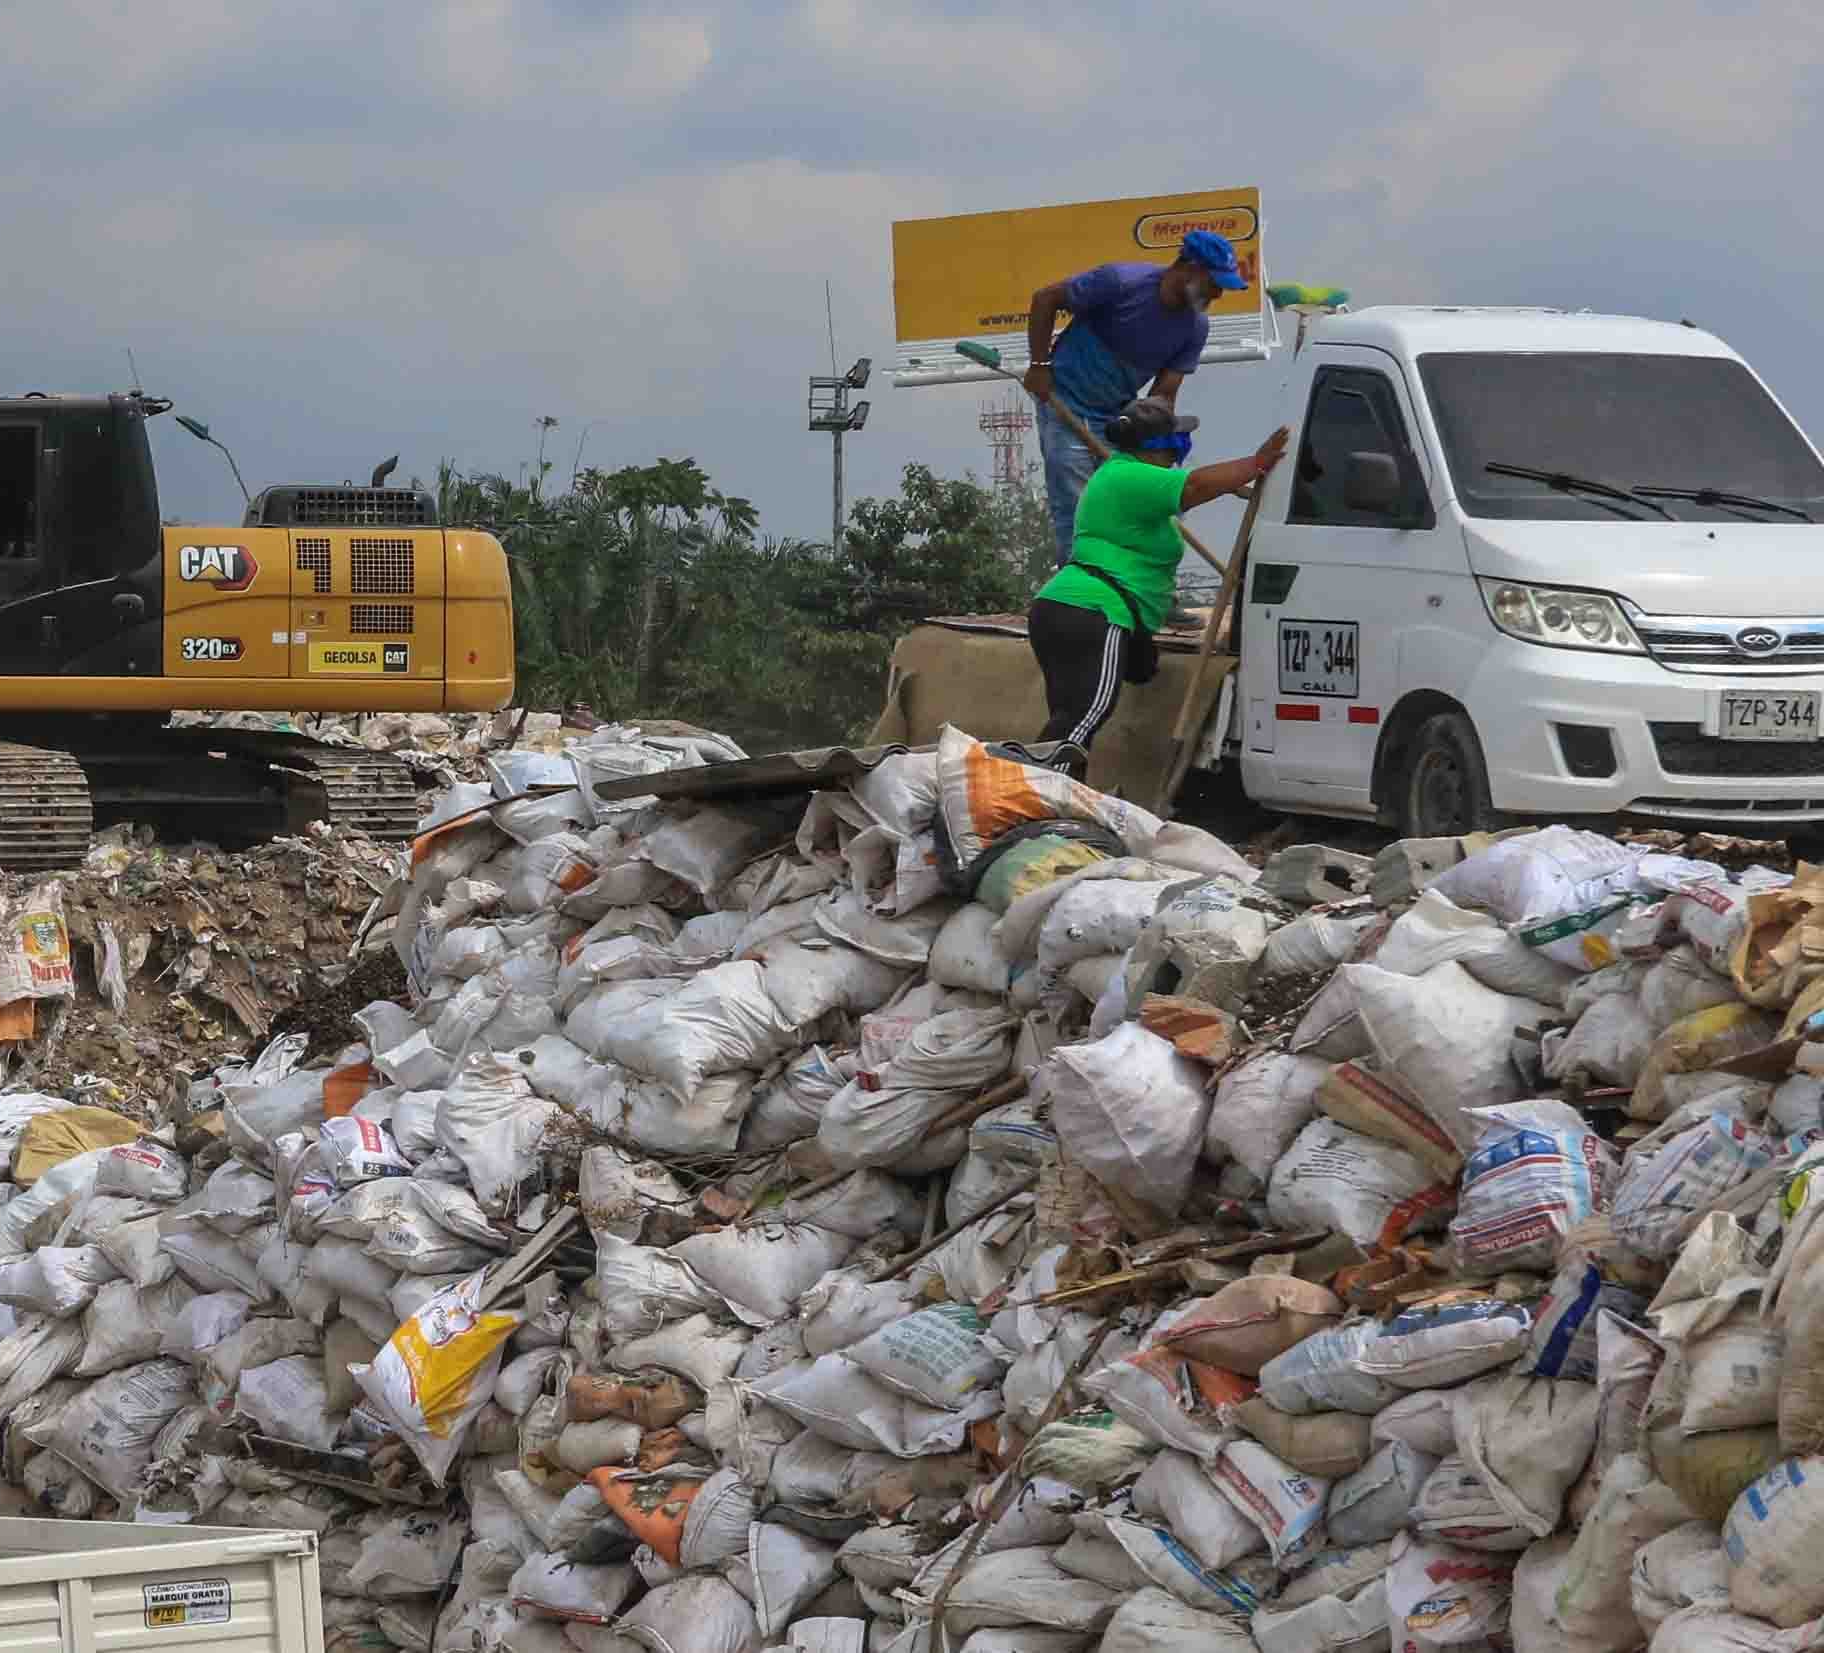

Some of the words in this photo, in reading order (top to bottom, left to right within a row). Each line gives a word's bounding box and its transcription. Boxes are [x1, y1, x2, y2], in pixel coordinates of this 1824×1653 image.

[180, 546, 238, 581] CAT
[182, 638, 222, 659] 320
[324, 650, 377, 664] GECOLSA
[385, 651, 407, 664] CAT
[1302, 682, 1336, 692] CALI
[1726, 698, 1768, 726] TZP
[1775, 699, 1816, 727] 344
[367, 1164, 380, 1175] 25
[152, 1592, 189, 1602] MARQUE
[191, 1589, 224, 1599] GRATIS
